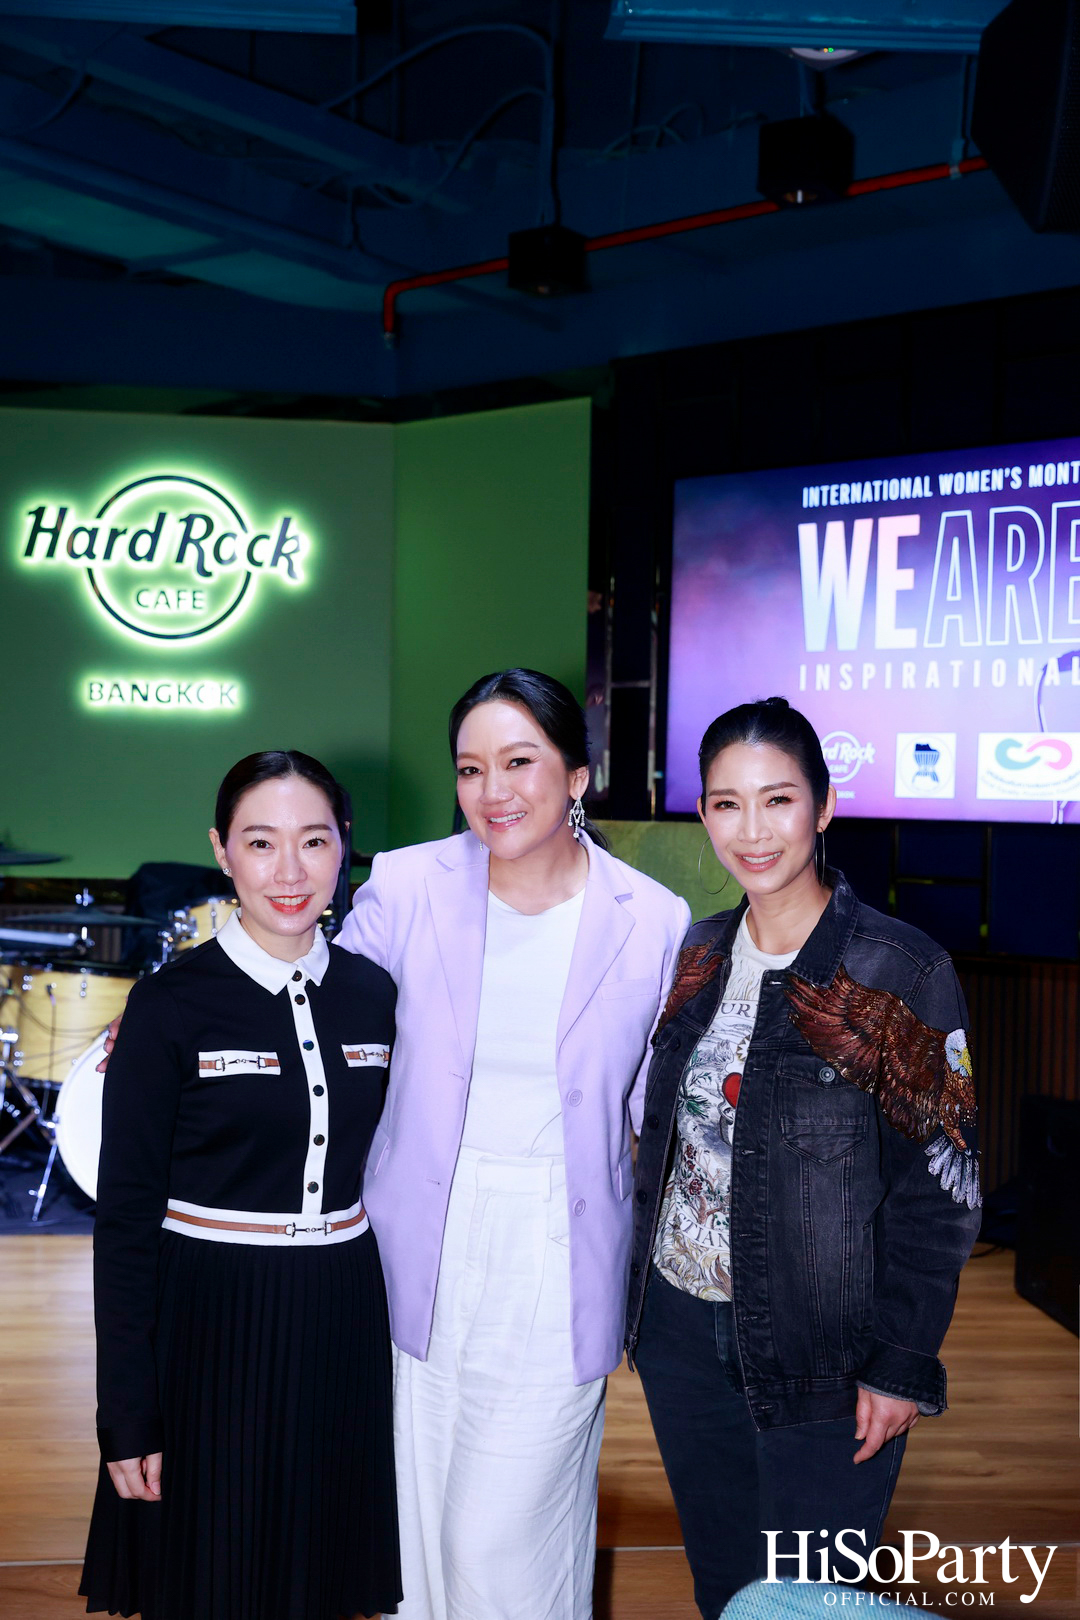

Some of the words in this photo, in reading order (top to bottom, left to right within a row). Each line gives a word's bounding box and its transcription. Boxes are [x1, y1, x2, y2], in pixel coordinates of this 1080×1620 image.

[802, 475, 933, 508] INTERNATIONAL
[938, 466, 1022, 496] WOMEN'S
[24, 506, 166, 562] Hard
[175, 513, 301, 580] Rock
[136, 588, 205, 610] CAFE
[798, 514, 920, 652] WE
[923, 500, 1080, 648] ARE
